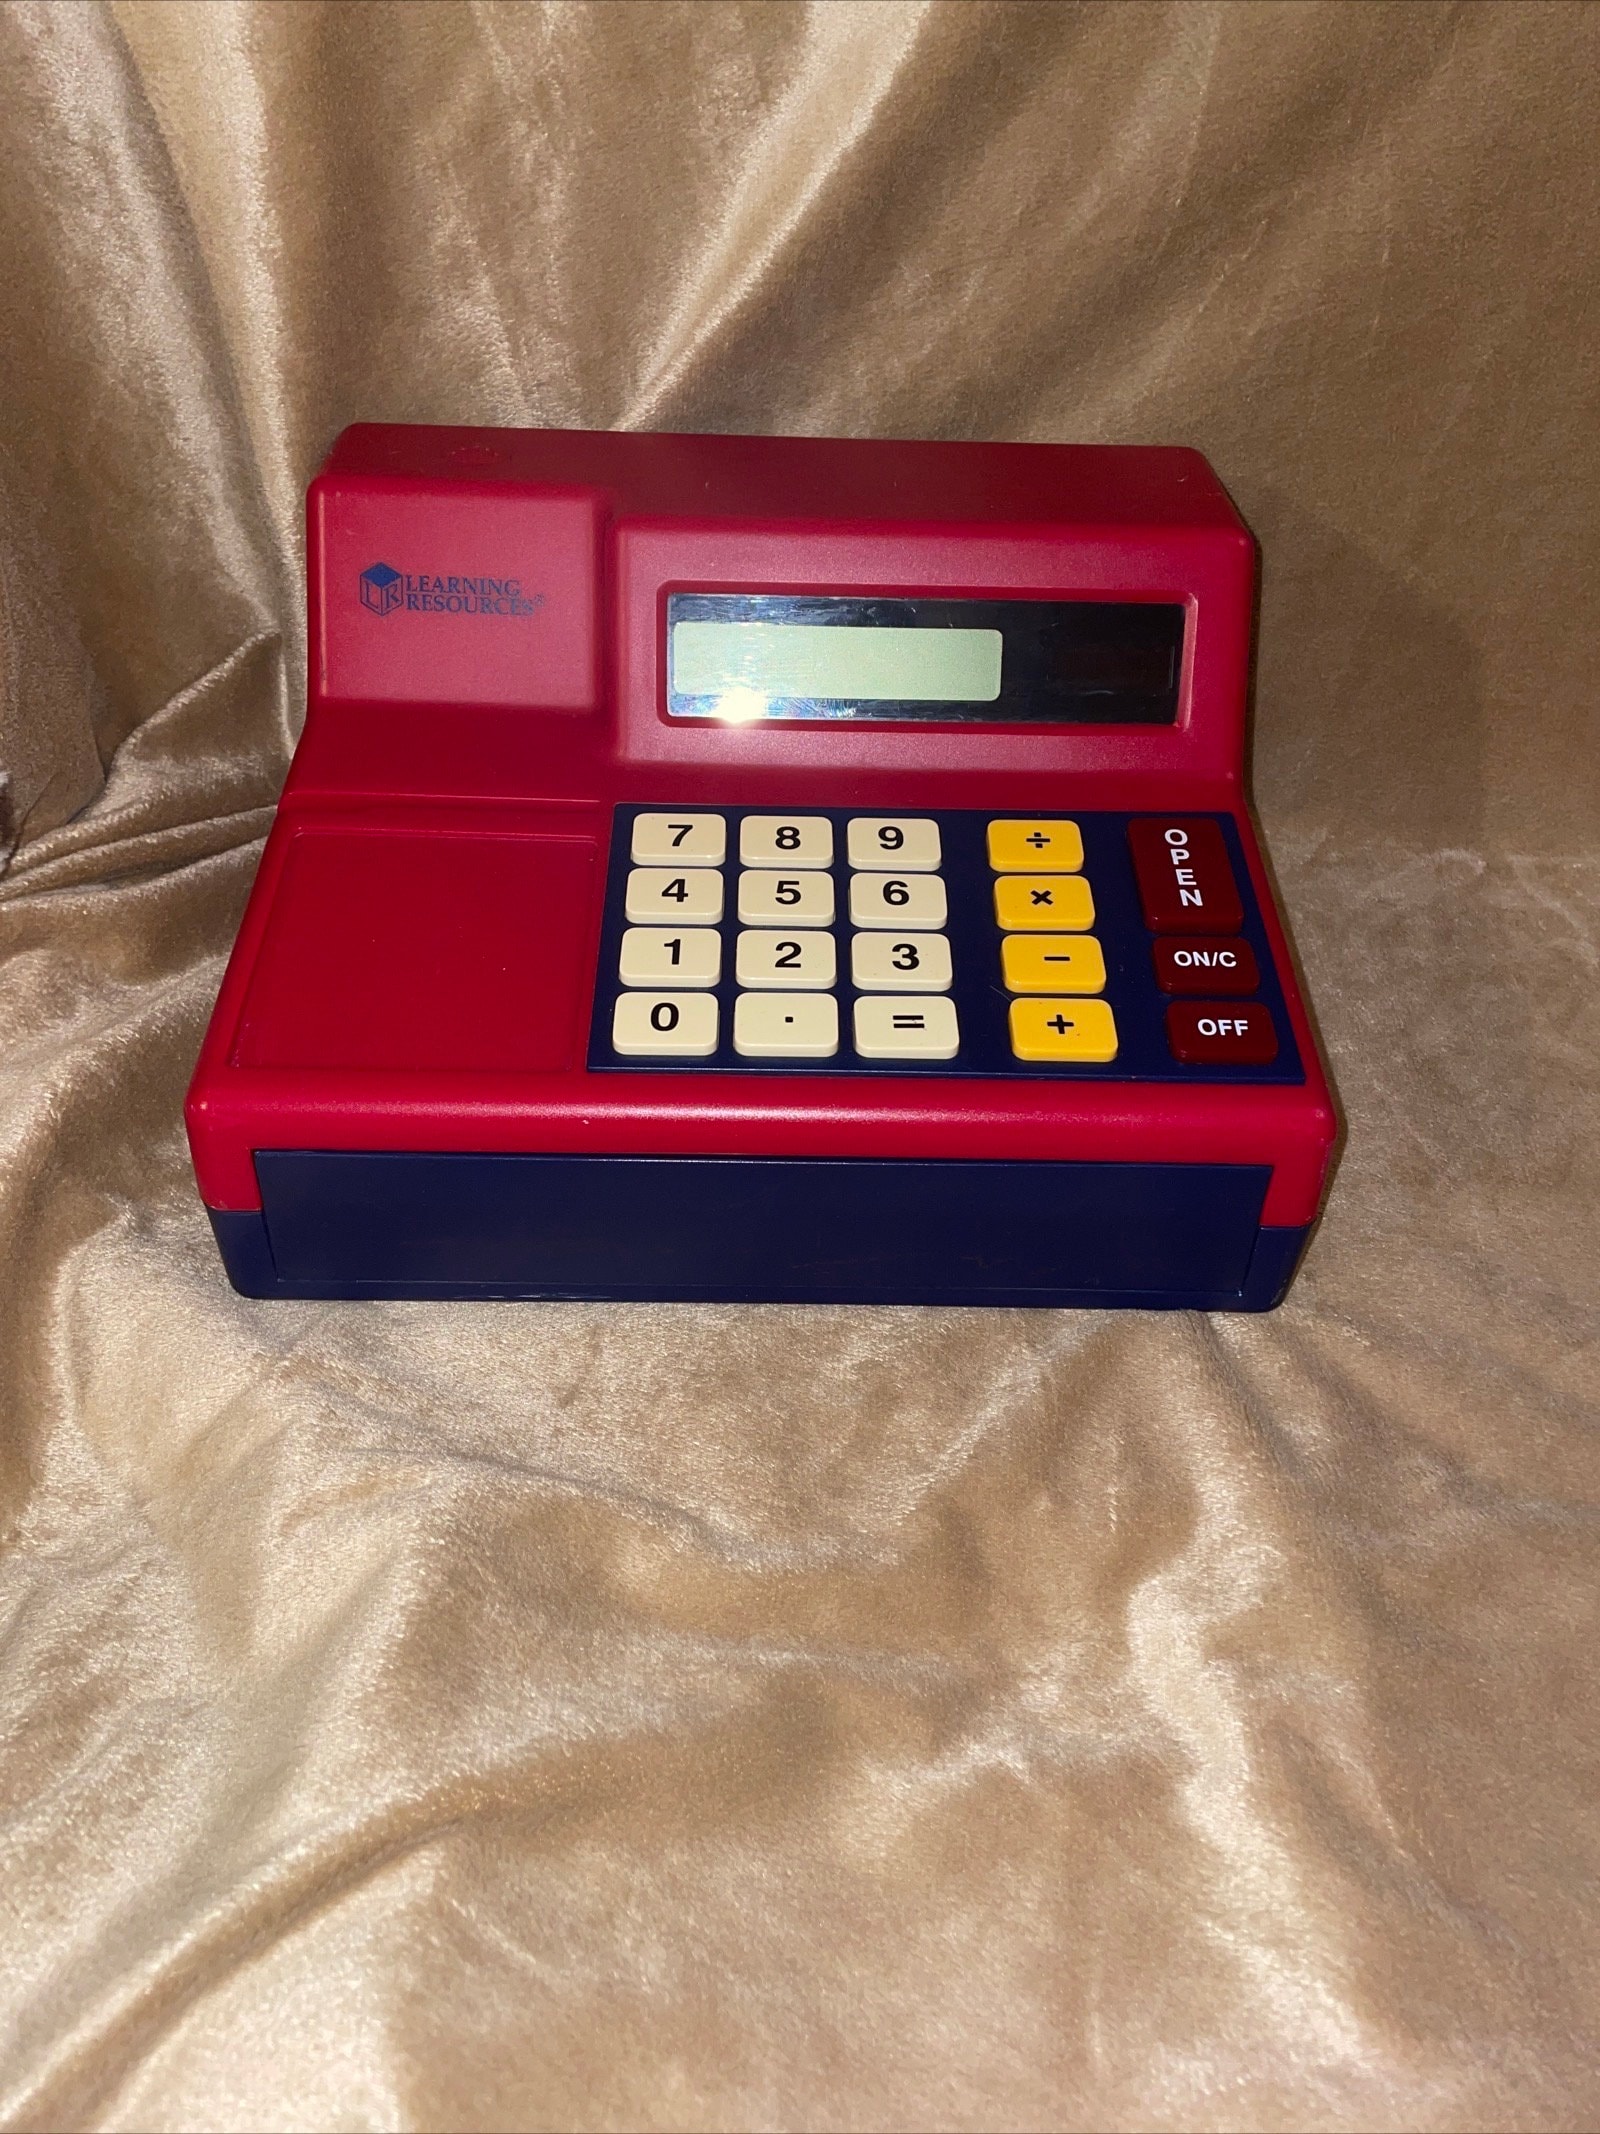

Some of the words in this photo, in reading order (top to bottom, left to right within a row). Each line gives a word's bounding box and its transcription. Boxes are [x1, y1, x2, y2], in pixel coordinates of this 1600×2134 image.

[405, 574, 522, 597] LEARNING
[667, 824, 694, 847] 7
[775, 826, 801, 850] 8
[877, 826, 904, 850] 9
[1164, 828, 1204, 907] OPEN
[661, 878, 689, 902] 4
[775, 880, 802, 905] 5
[882, 880, 910, 906] 6
[663, 938, 682, 965] 1
[774, 941, 802, 969] 2
[891, 943, 920, 970] 3
[1173, 951, 1237, 968] ON/C
[650, 1002, 680, 1032] 0
[1197, 1018, 1249, 1037] OFF
